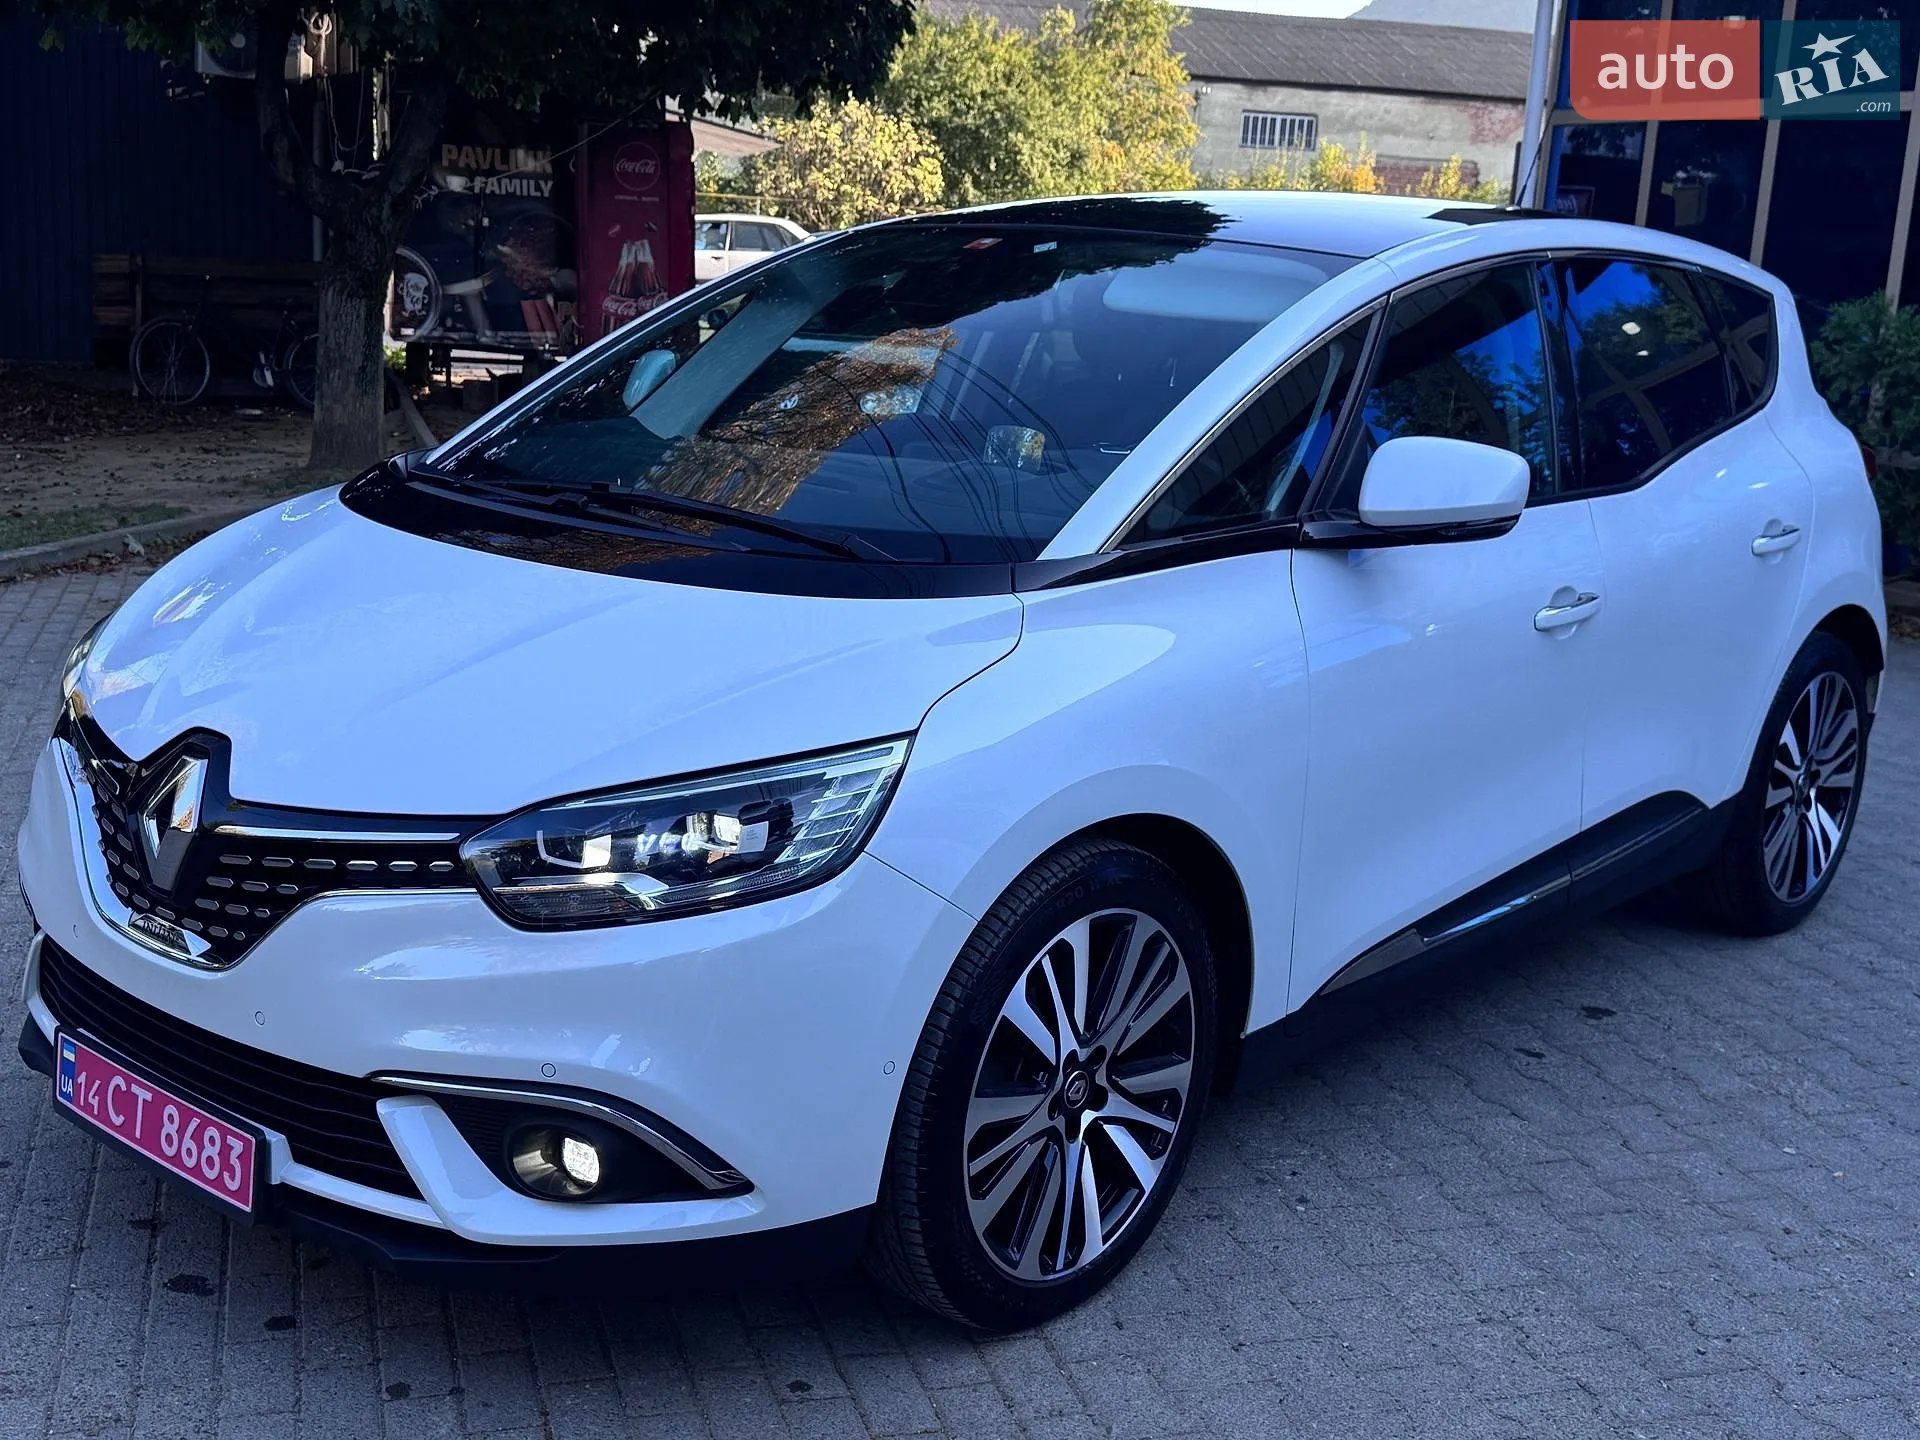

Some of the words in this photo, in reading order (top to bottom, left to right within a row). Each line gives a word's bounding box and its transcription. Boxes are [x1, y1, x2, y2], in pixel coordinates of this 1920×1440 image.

[441, 143, 553, 174] PAVLIUK
[473, 175, 554, 198] FAMILY
[61, 1073, 73, 1097] UA
[77, 1071, 101, 1115] 14
[106, 1074, 153, 1139] CT
[160, 1104, 245, 1192] 8683
